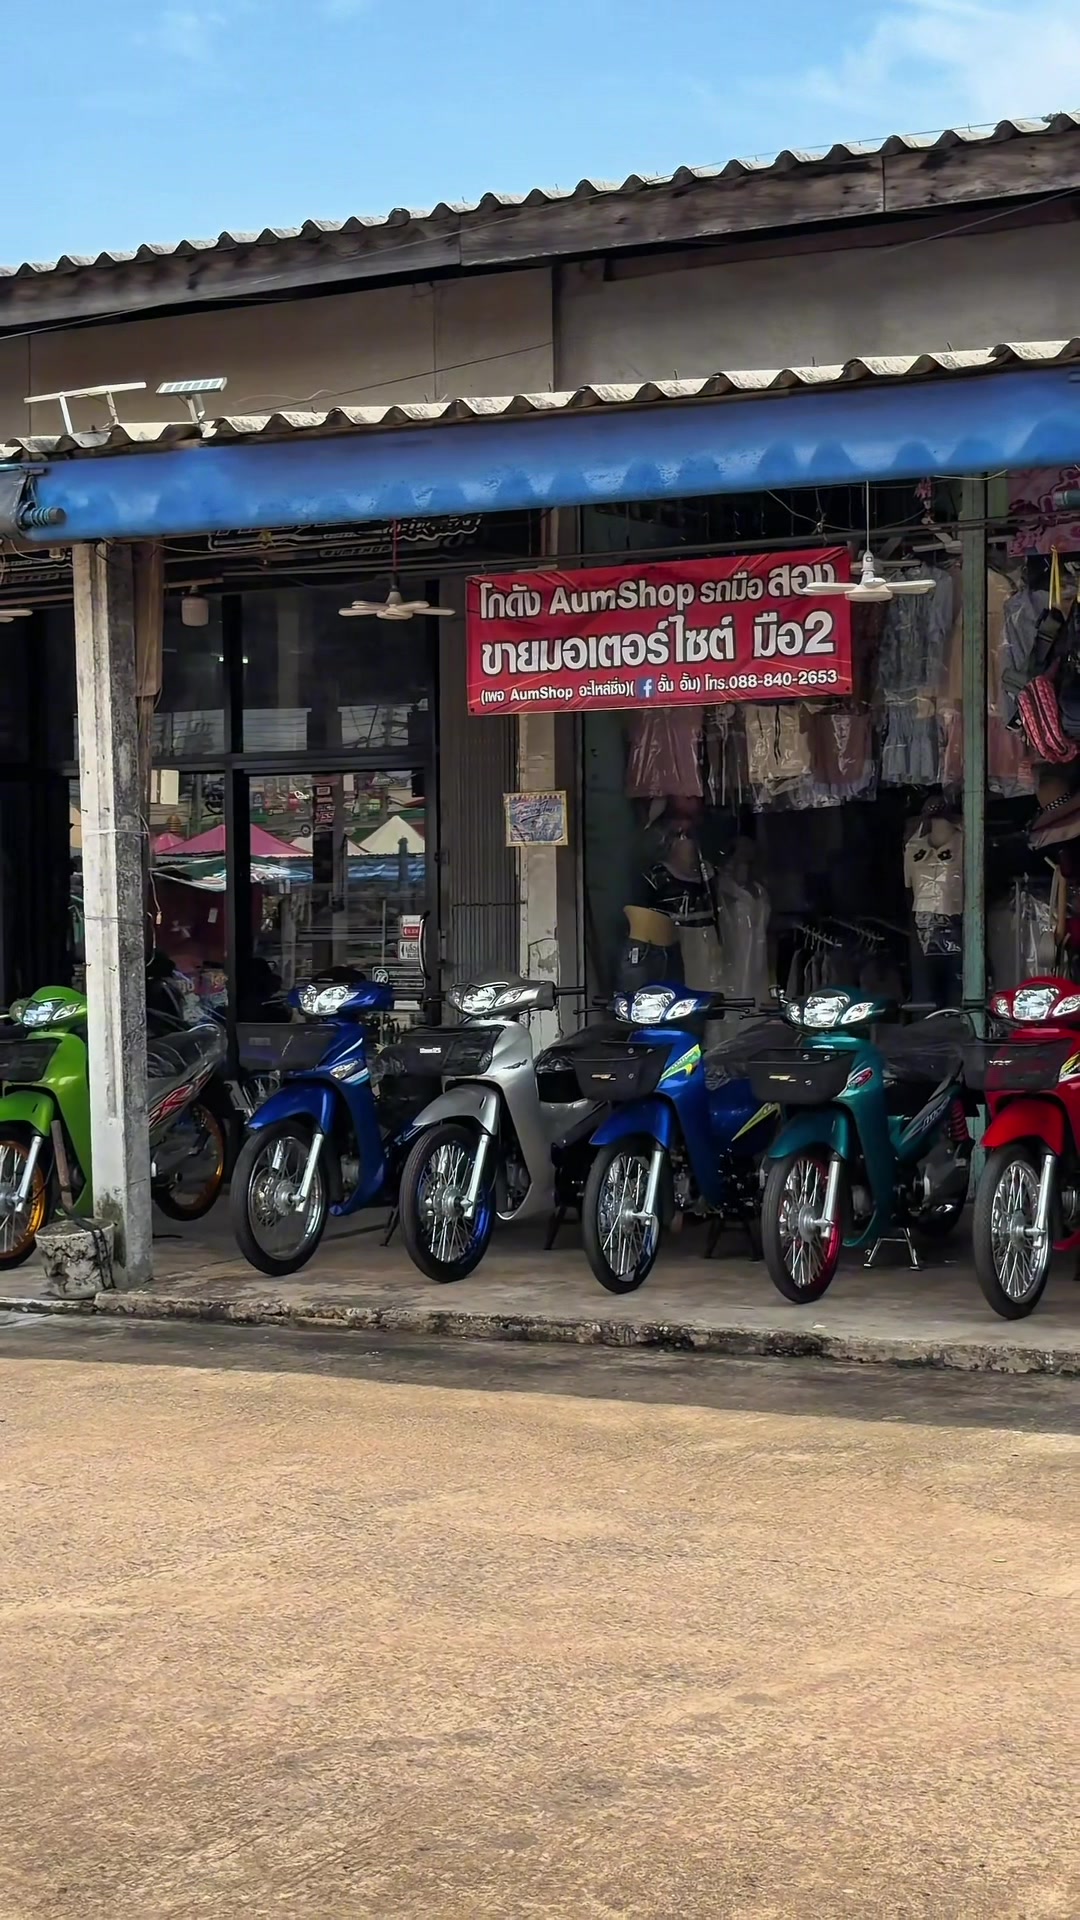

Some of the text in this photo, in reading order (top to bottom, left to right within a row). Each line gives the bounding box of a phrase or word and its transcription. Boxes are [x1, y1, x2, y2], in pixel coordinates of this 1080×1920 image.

[481, 583, 541, 619] โกดัง
[549, 580, 695, 615] AumShop
[700, 571, 764, 603] รถมือ
[753, 611, 834, 658] มือ2
[510, 686, 573, 701] AumShop
[705, 669, 837, 691] โทร.088-840-2653
